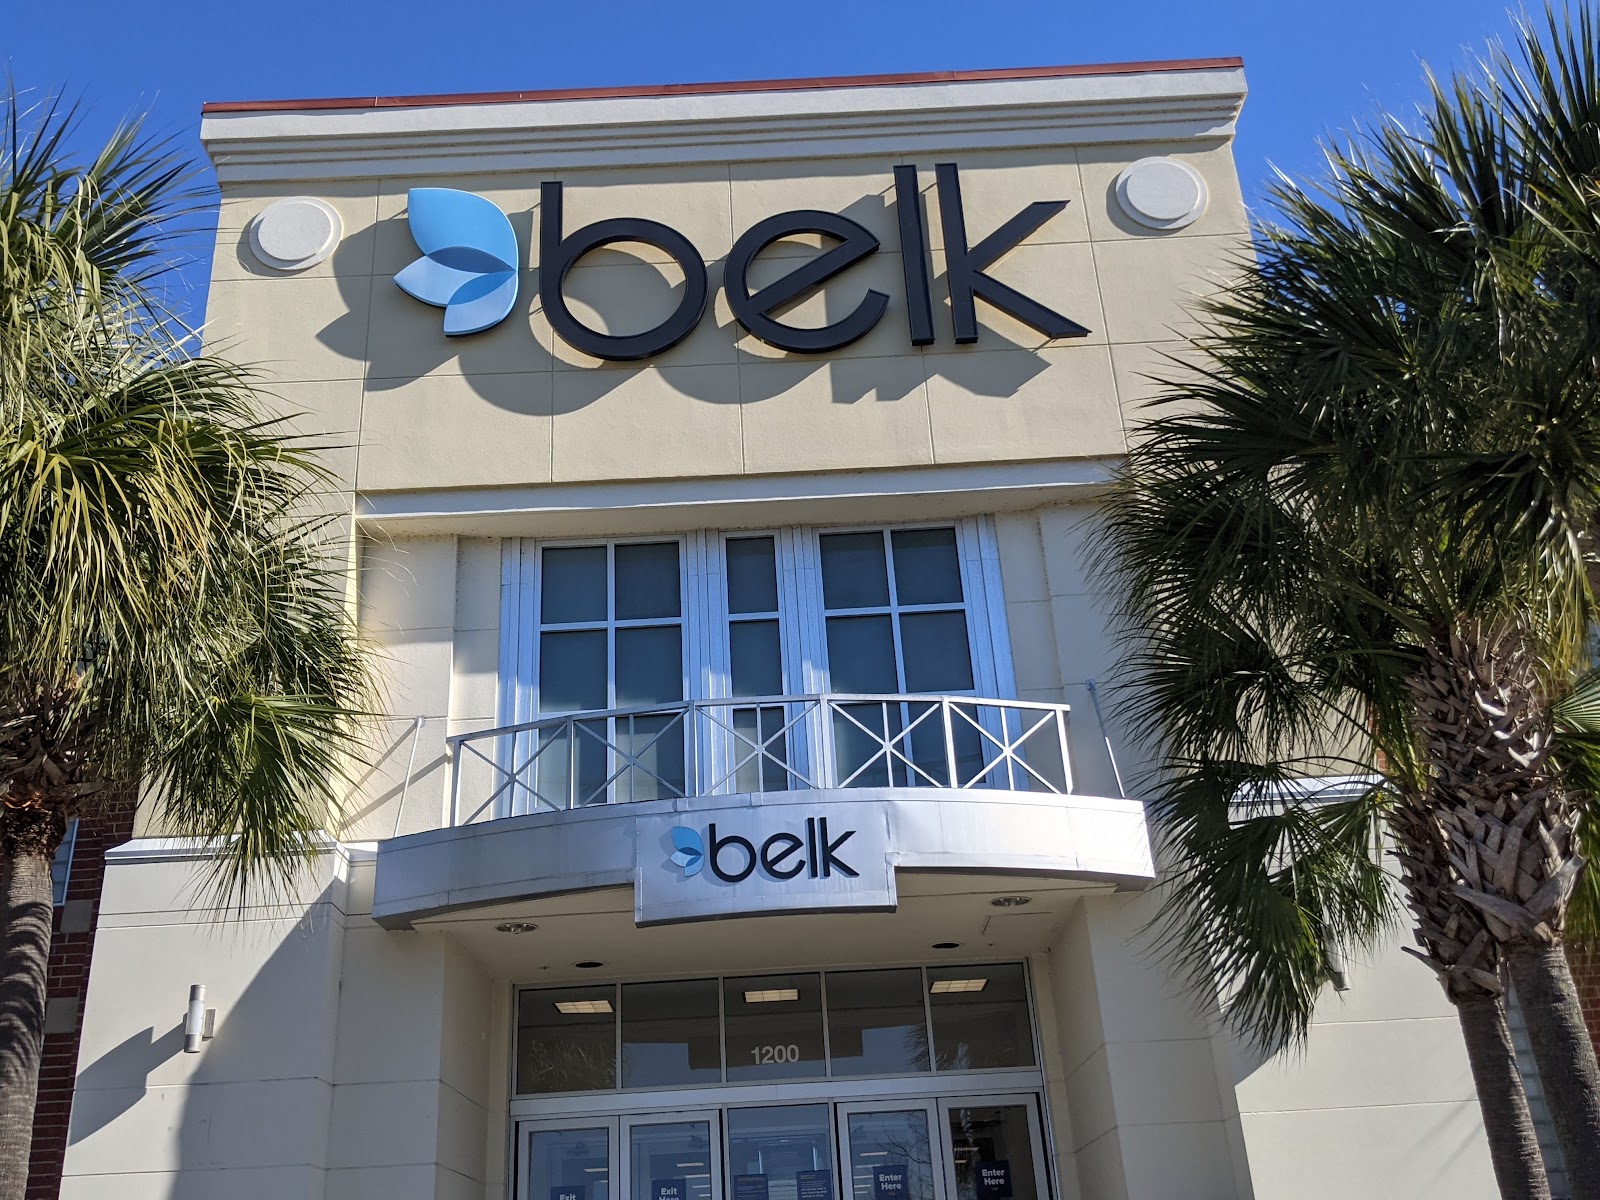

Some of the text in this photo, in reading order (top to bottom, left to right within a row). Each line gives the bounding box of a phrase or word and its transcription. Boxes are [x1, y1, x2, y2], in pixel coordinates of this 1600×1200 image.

[539, 162, 1092, 361] belk
[708, 817, 860, 883] belk
[750, 1044, 800, 1065] 1200
[981, 1168, 1005, 1177] Enter
[879, 1173, 902, 1182] Enter
[983, 1177, 1005, 1186] Here
[881, 1182, 902, 1191] Here
[660, 1187, 678, 1196] Exit
